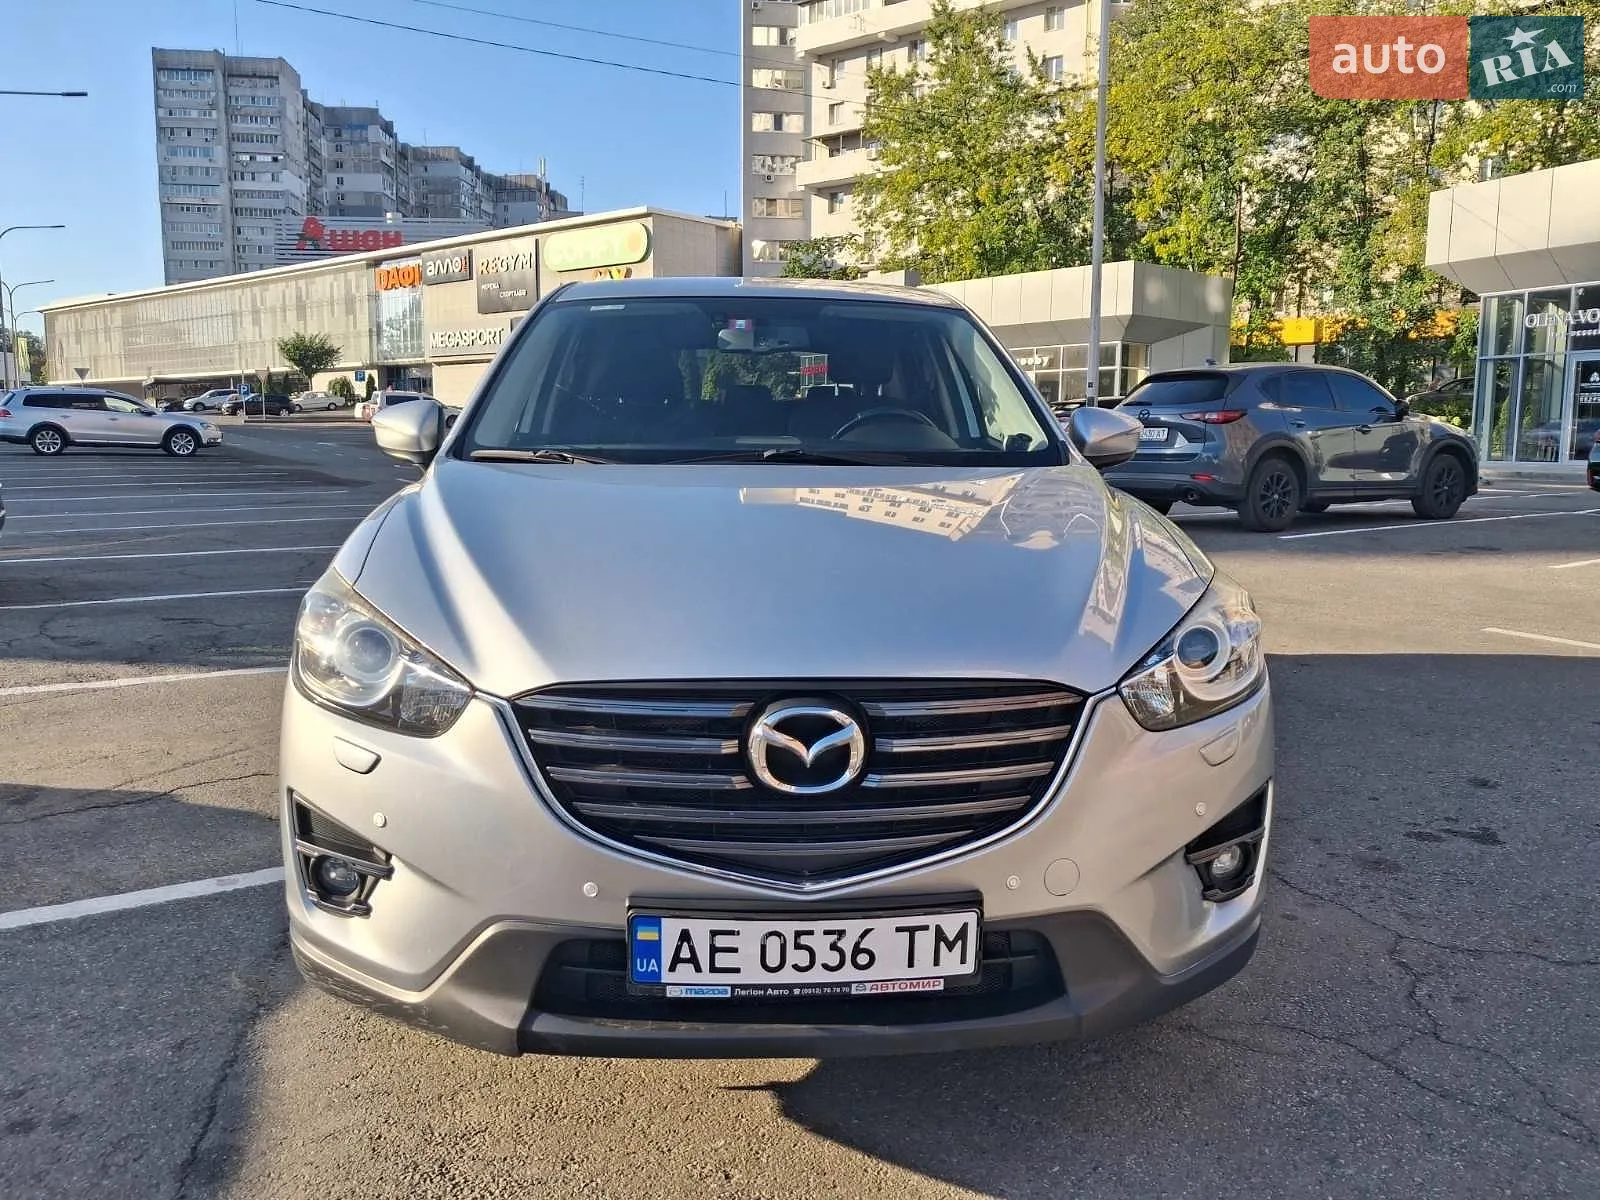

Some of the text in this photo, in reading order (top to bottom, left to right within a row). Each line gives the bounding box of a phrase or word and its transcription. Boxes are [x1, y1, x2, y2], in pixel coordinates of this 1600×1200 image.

[480, 252, 532, 275] REGYM
[430, 328, 504, 349] MEGASPORT
[668, 922, 969, 974] AE 0536 TM
[636, 958, 659, 973] UA
[766, 987, 790, 996] Авто
[869, 980, 942, 993] АВТОМИР
